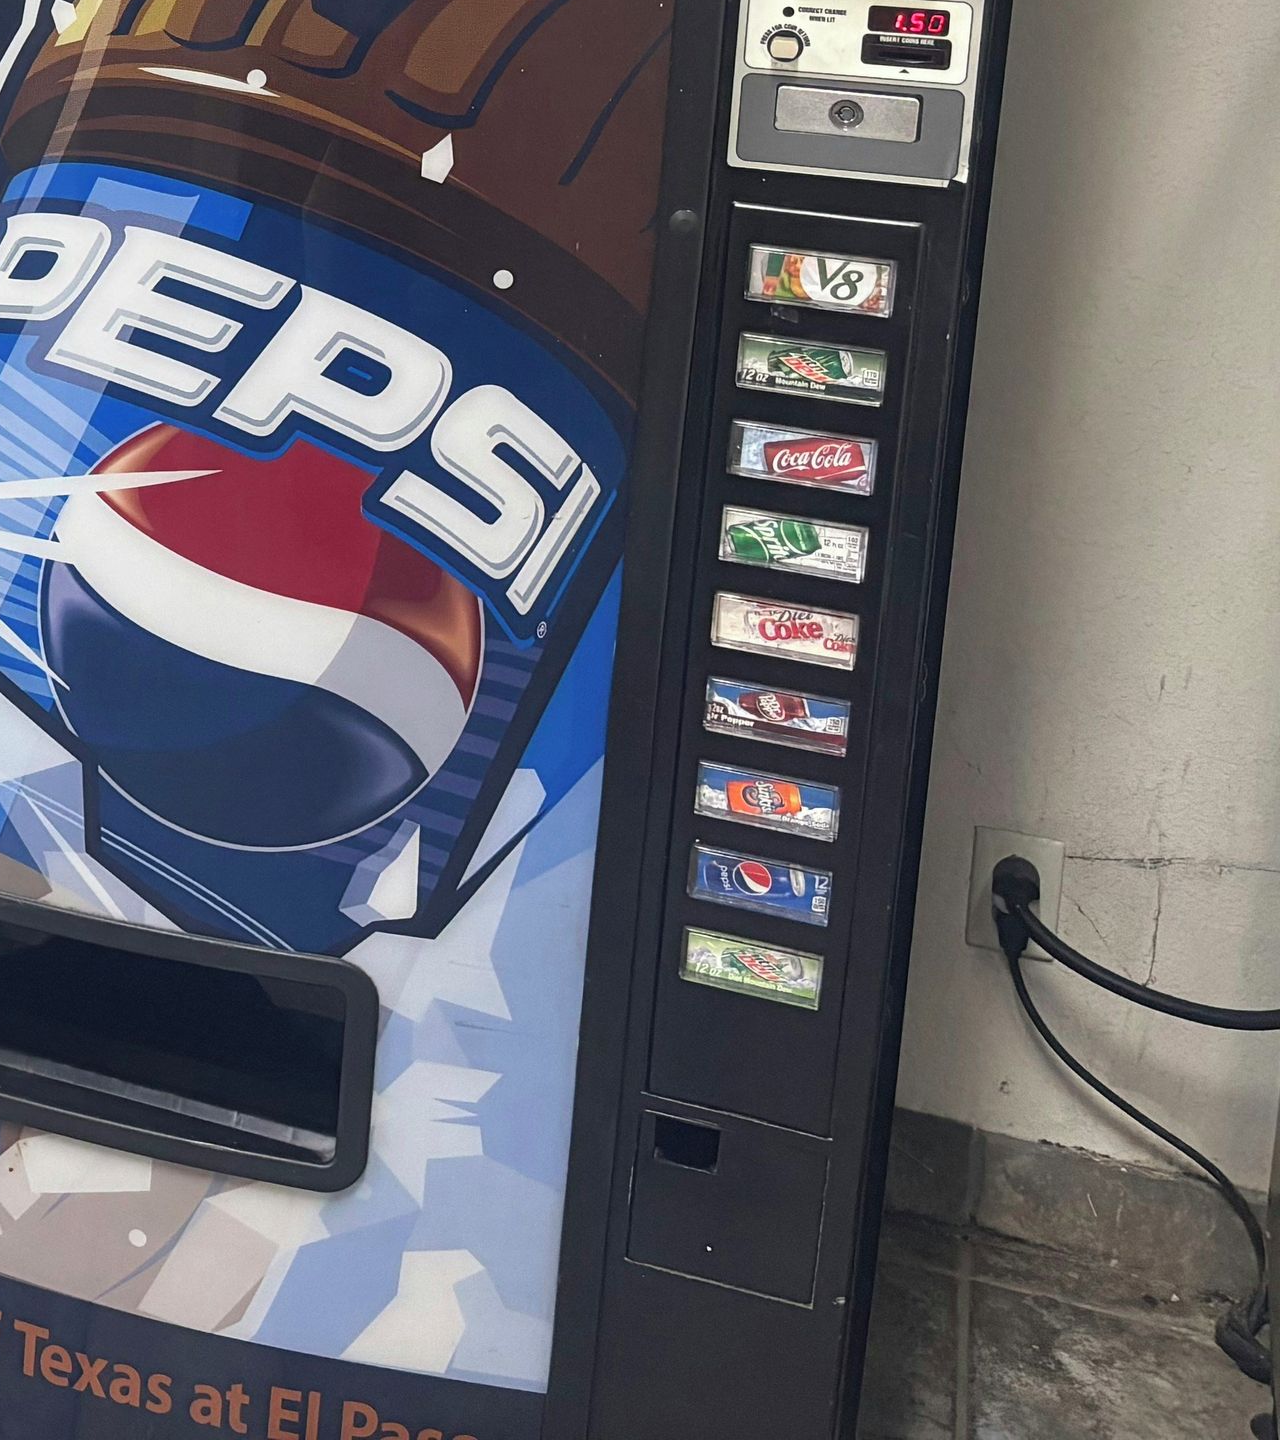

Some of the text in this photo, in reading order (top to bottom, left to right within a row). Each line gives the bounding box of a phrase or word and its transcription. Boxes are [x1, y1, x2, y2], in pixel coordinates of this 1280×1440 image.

[895, 13, 945, 33] 1.50
[772, 23, 783, 32] FOR
[783, 23, 798, 31] COIN
[797, 28, 811, 47] RETURN
[880, 35, 900, 43] INSERT
[901, 37, 920, 45] COINS
[817, 257, 864, 301] V8
[741, 368, 769, 383] 12 oz
[775, 377, 826, 391] Mountain Dew
[773, 442, 853, 473] Coca-Cola
[778, 609, 814, 623] Diet
[758, 617, 824, 641] Coke
[720, 714, 755, 727] Pepper
[814, 875, 829, 889] 12
[695, 962, 722, 977] 12 oz
[13, 1318, 173, 1414] Texas
[189, 1383, 251, 1435] at
[267, 1385, 322, 1440] El
